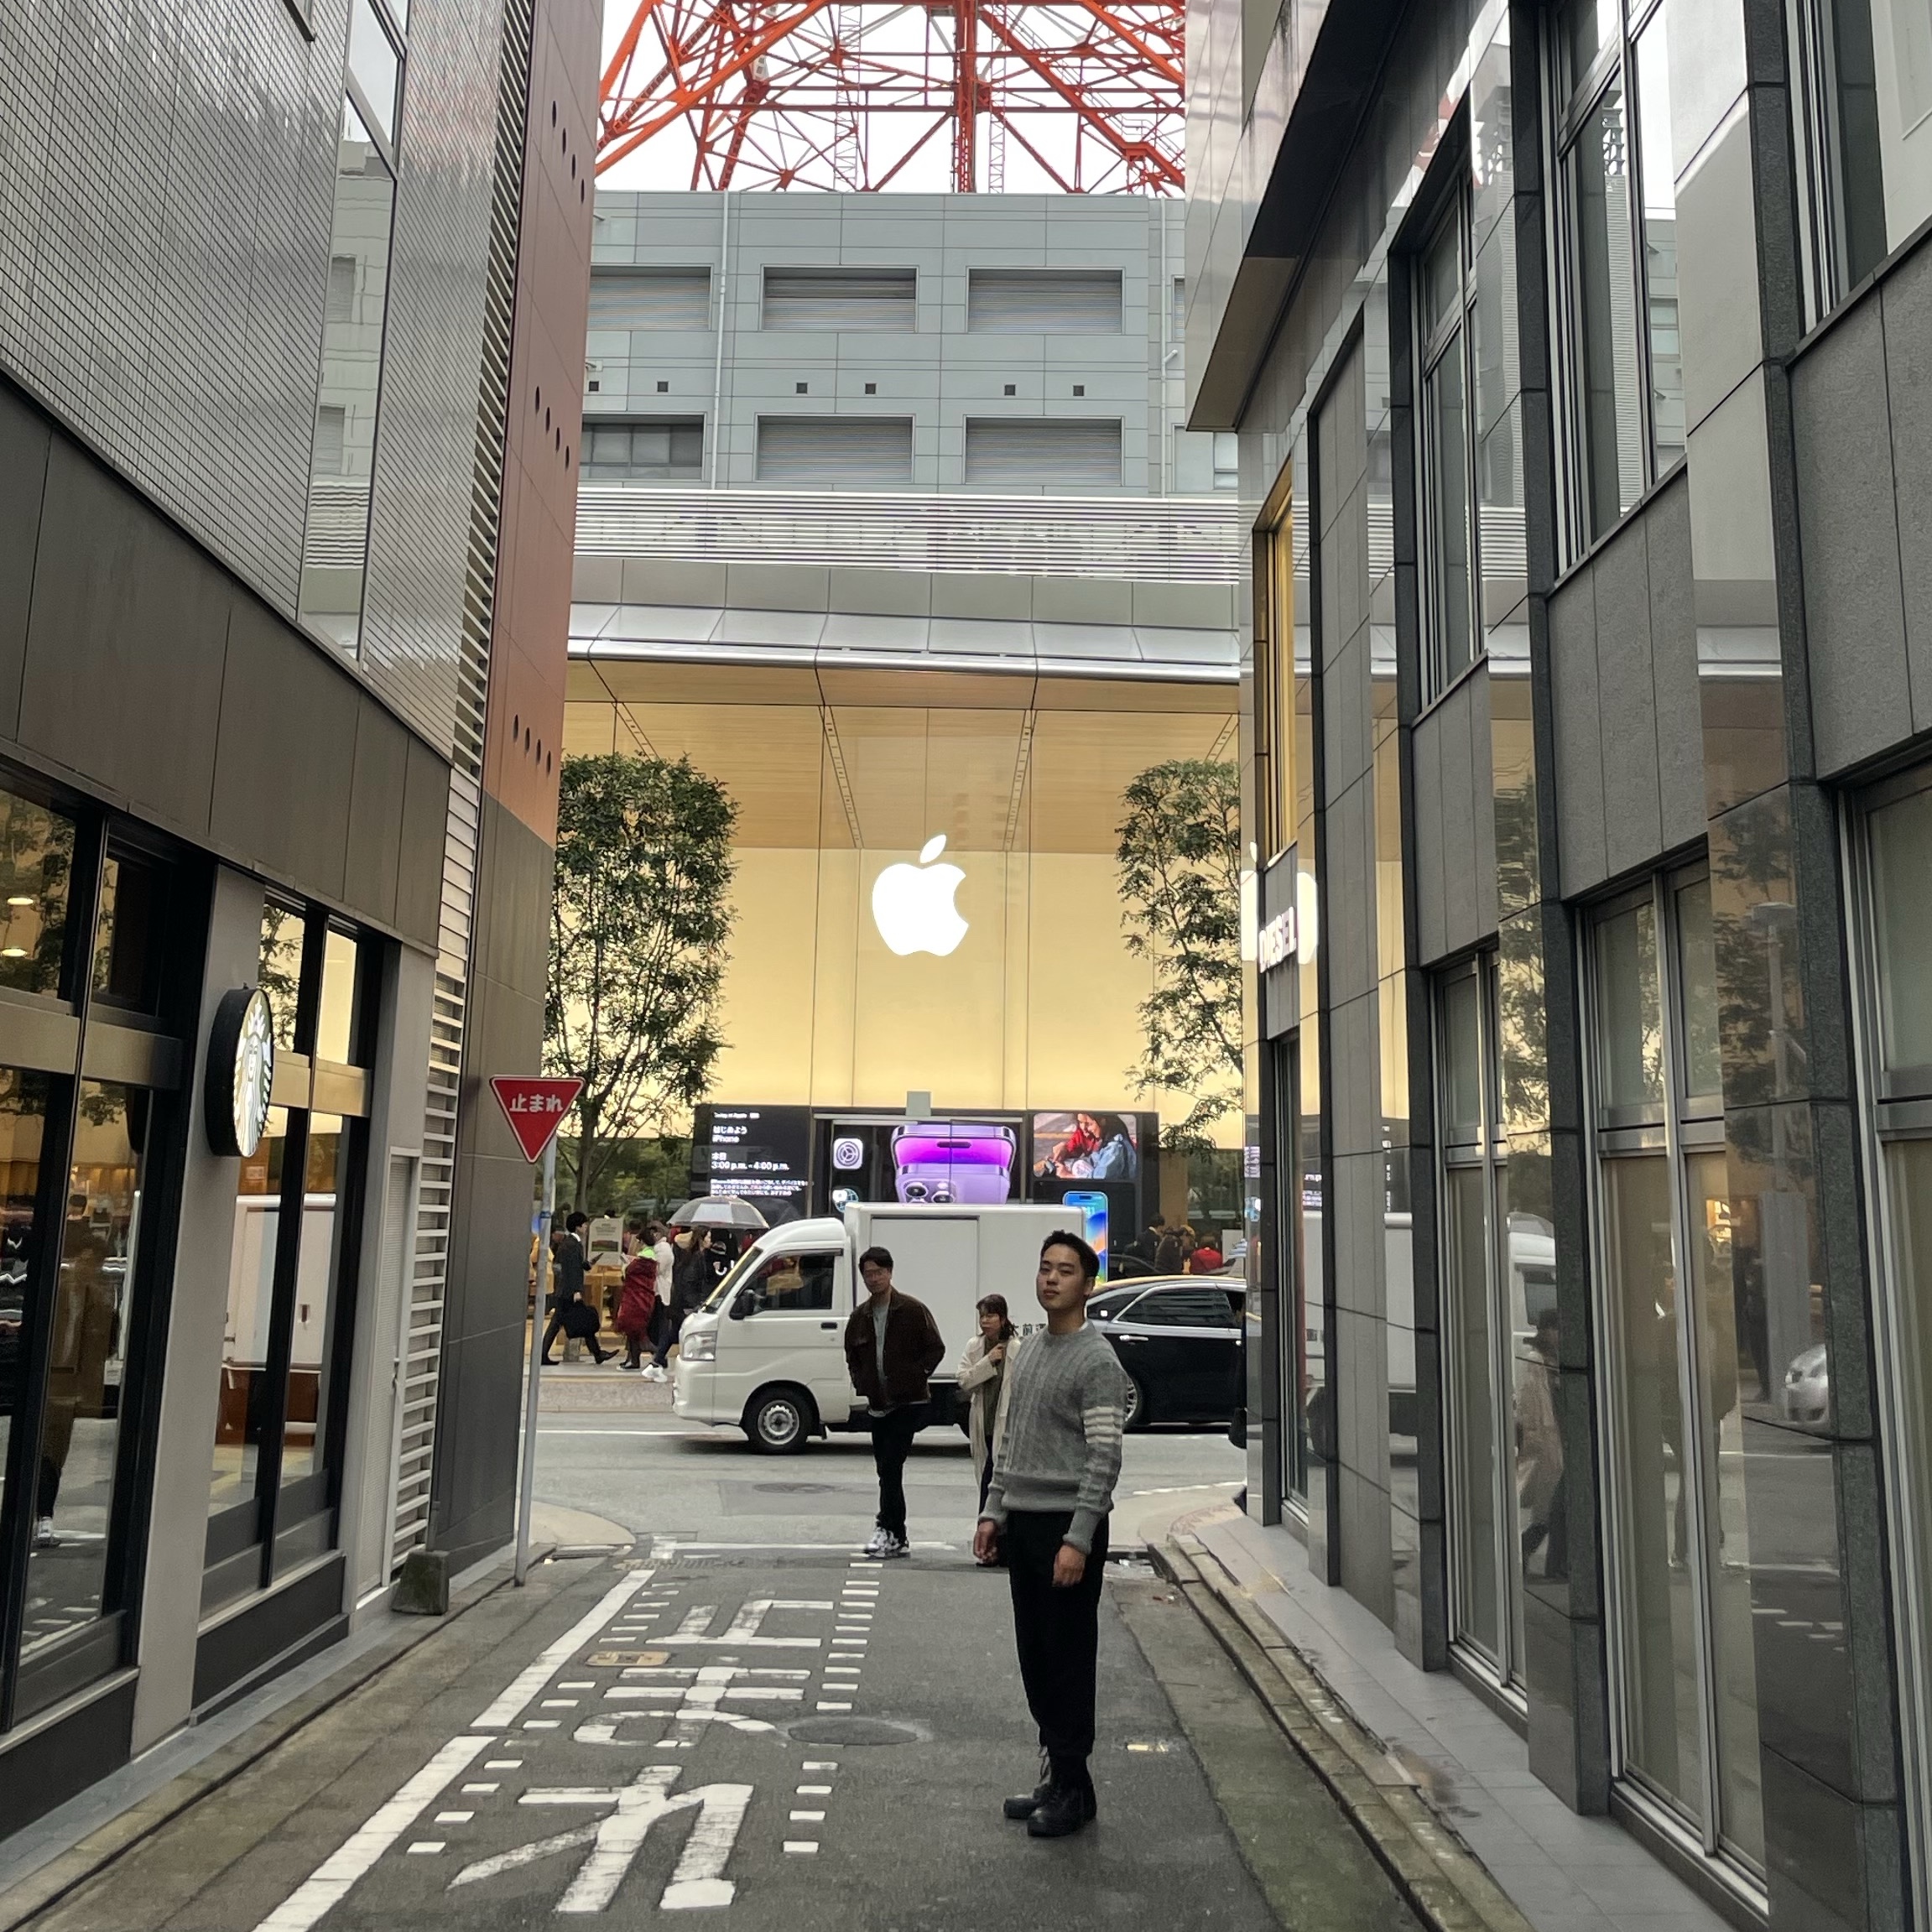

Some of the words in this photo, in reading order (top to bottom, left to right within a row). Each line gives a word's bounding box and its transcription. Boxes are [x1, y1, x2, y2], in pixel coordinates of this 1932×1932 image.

[1259, 906, 1297, 974] DIESEL
[509, 1093, 564, 1112] 止まれ
[713, 1126, 747, 1134] はじめよう
[773, 1163, 789, 1171] p.m.
[445, 1591, 835, 1912] 止まれ
